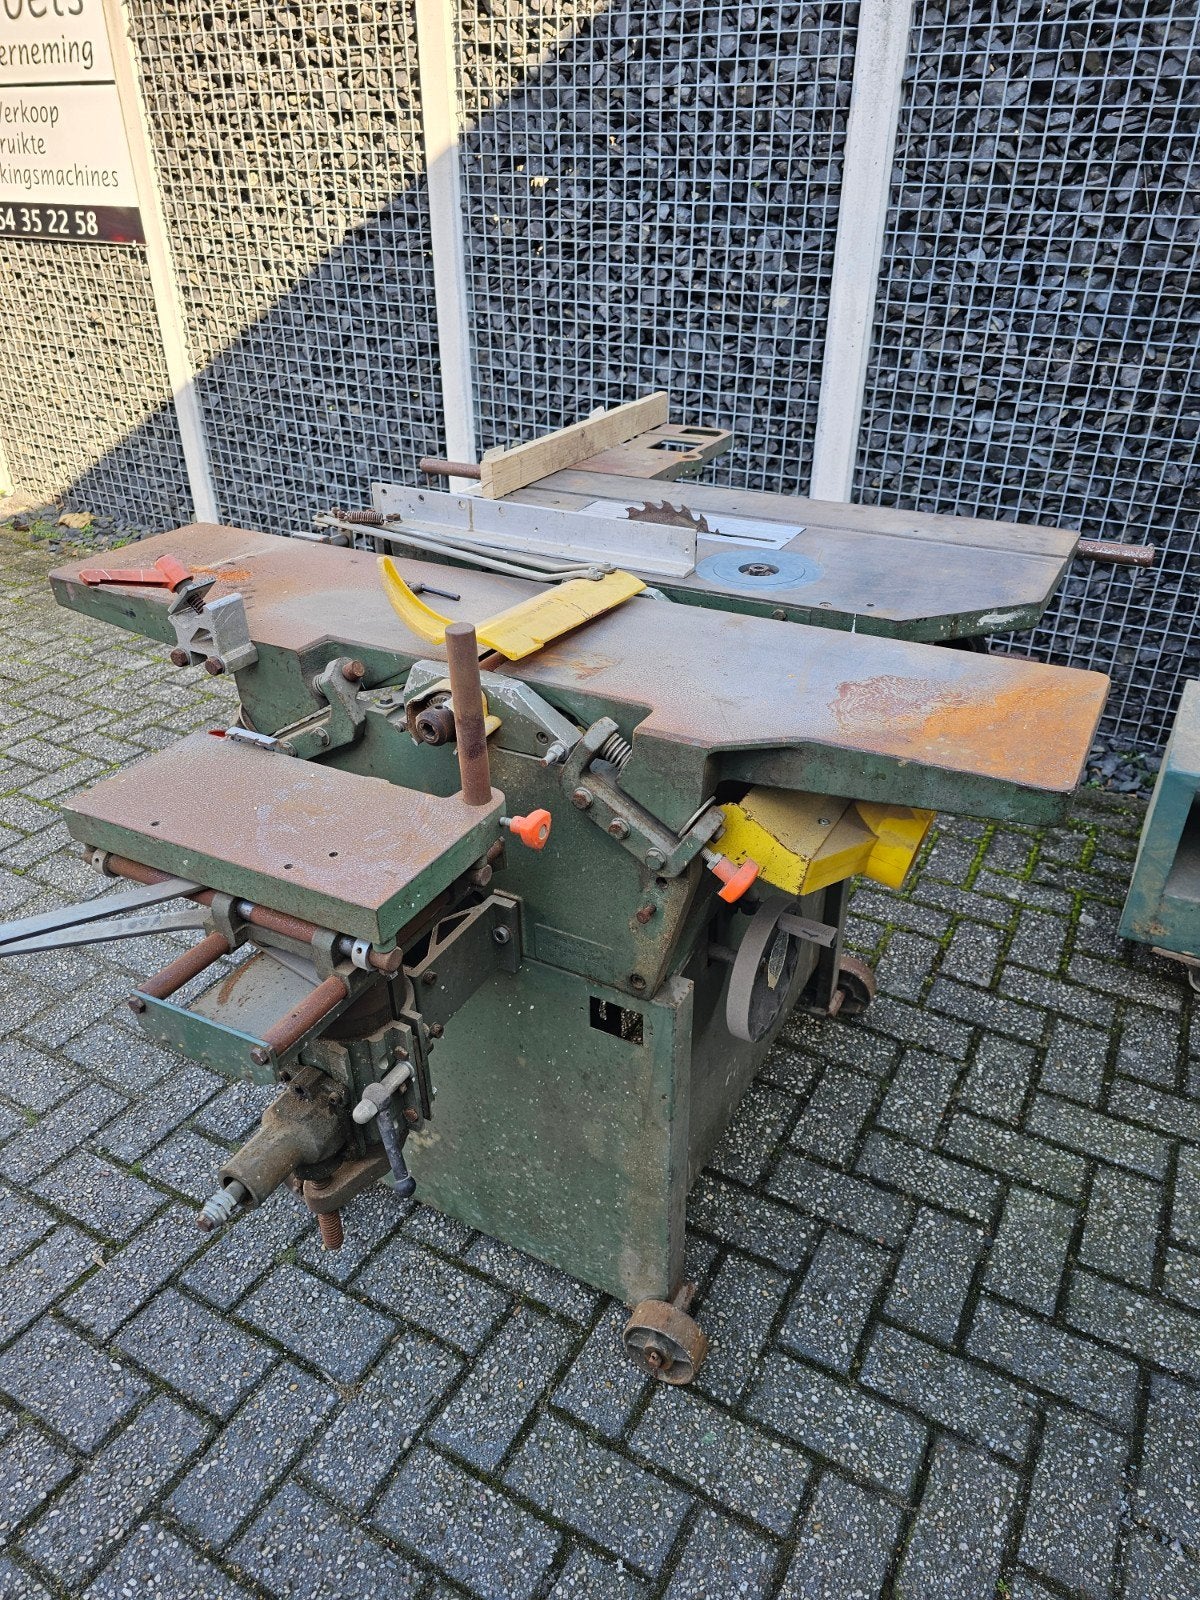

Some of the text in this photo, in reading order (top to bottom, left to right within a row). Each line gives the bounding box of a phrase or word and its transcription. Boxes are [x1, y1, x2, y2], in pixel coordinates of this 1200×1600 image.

[0, 34, 94, 70] erneming
[0, 99, 59, 128] erkoop
[0, 161, 119, 190] kingsmachines
[20, 207, 43, 233] 35
[46, 209, 70, 234] 22
[75, 210, 99, 236] 58
